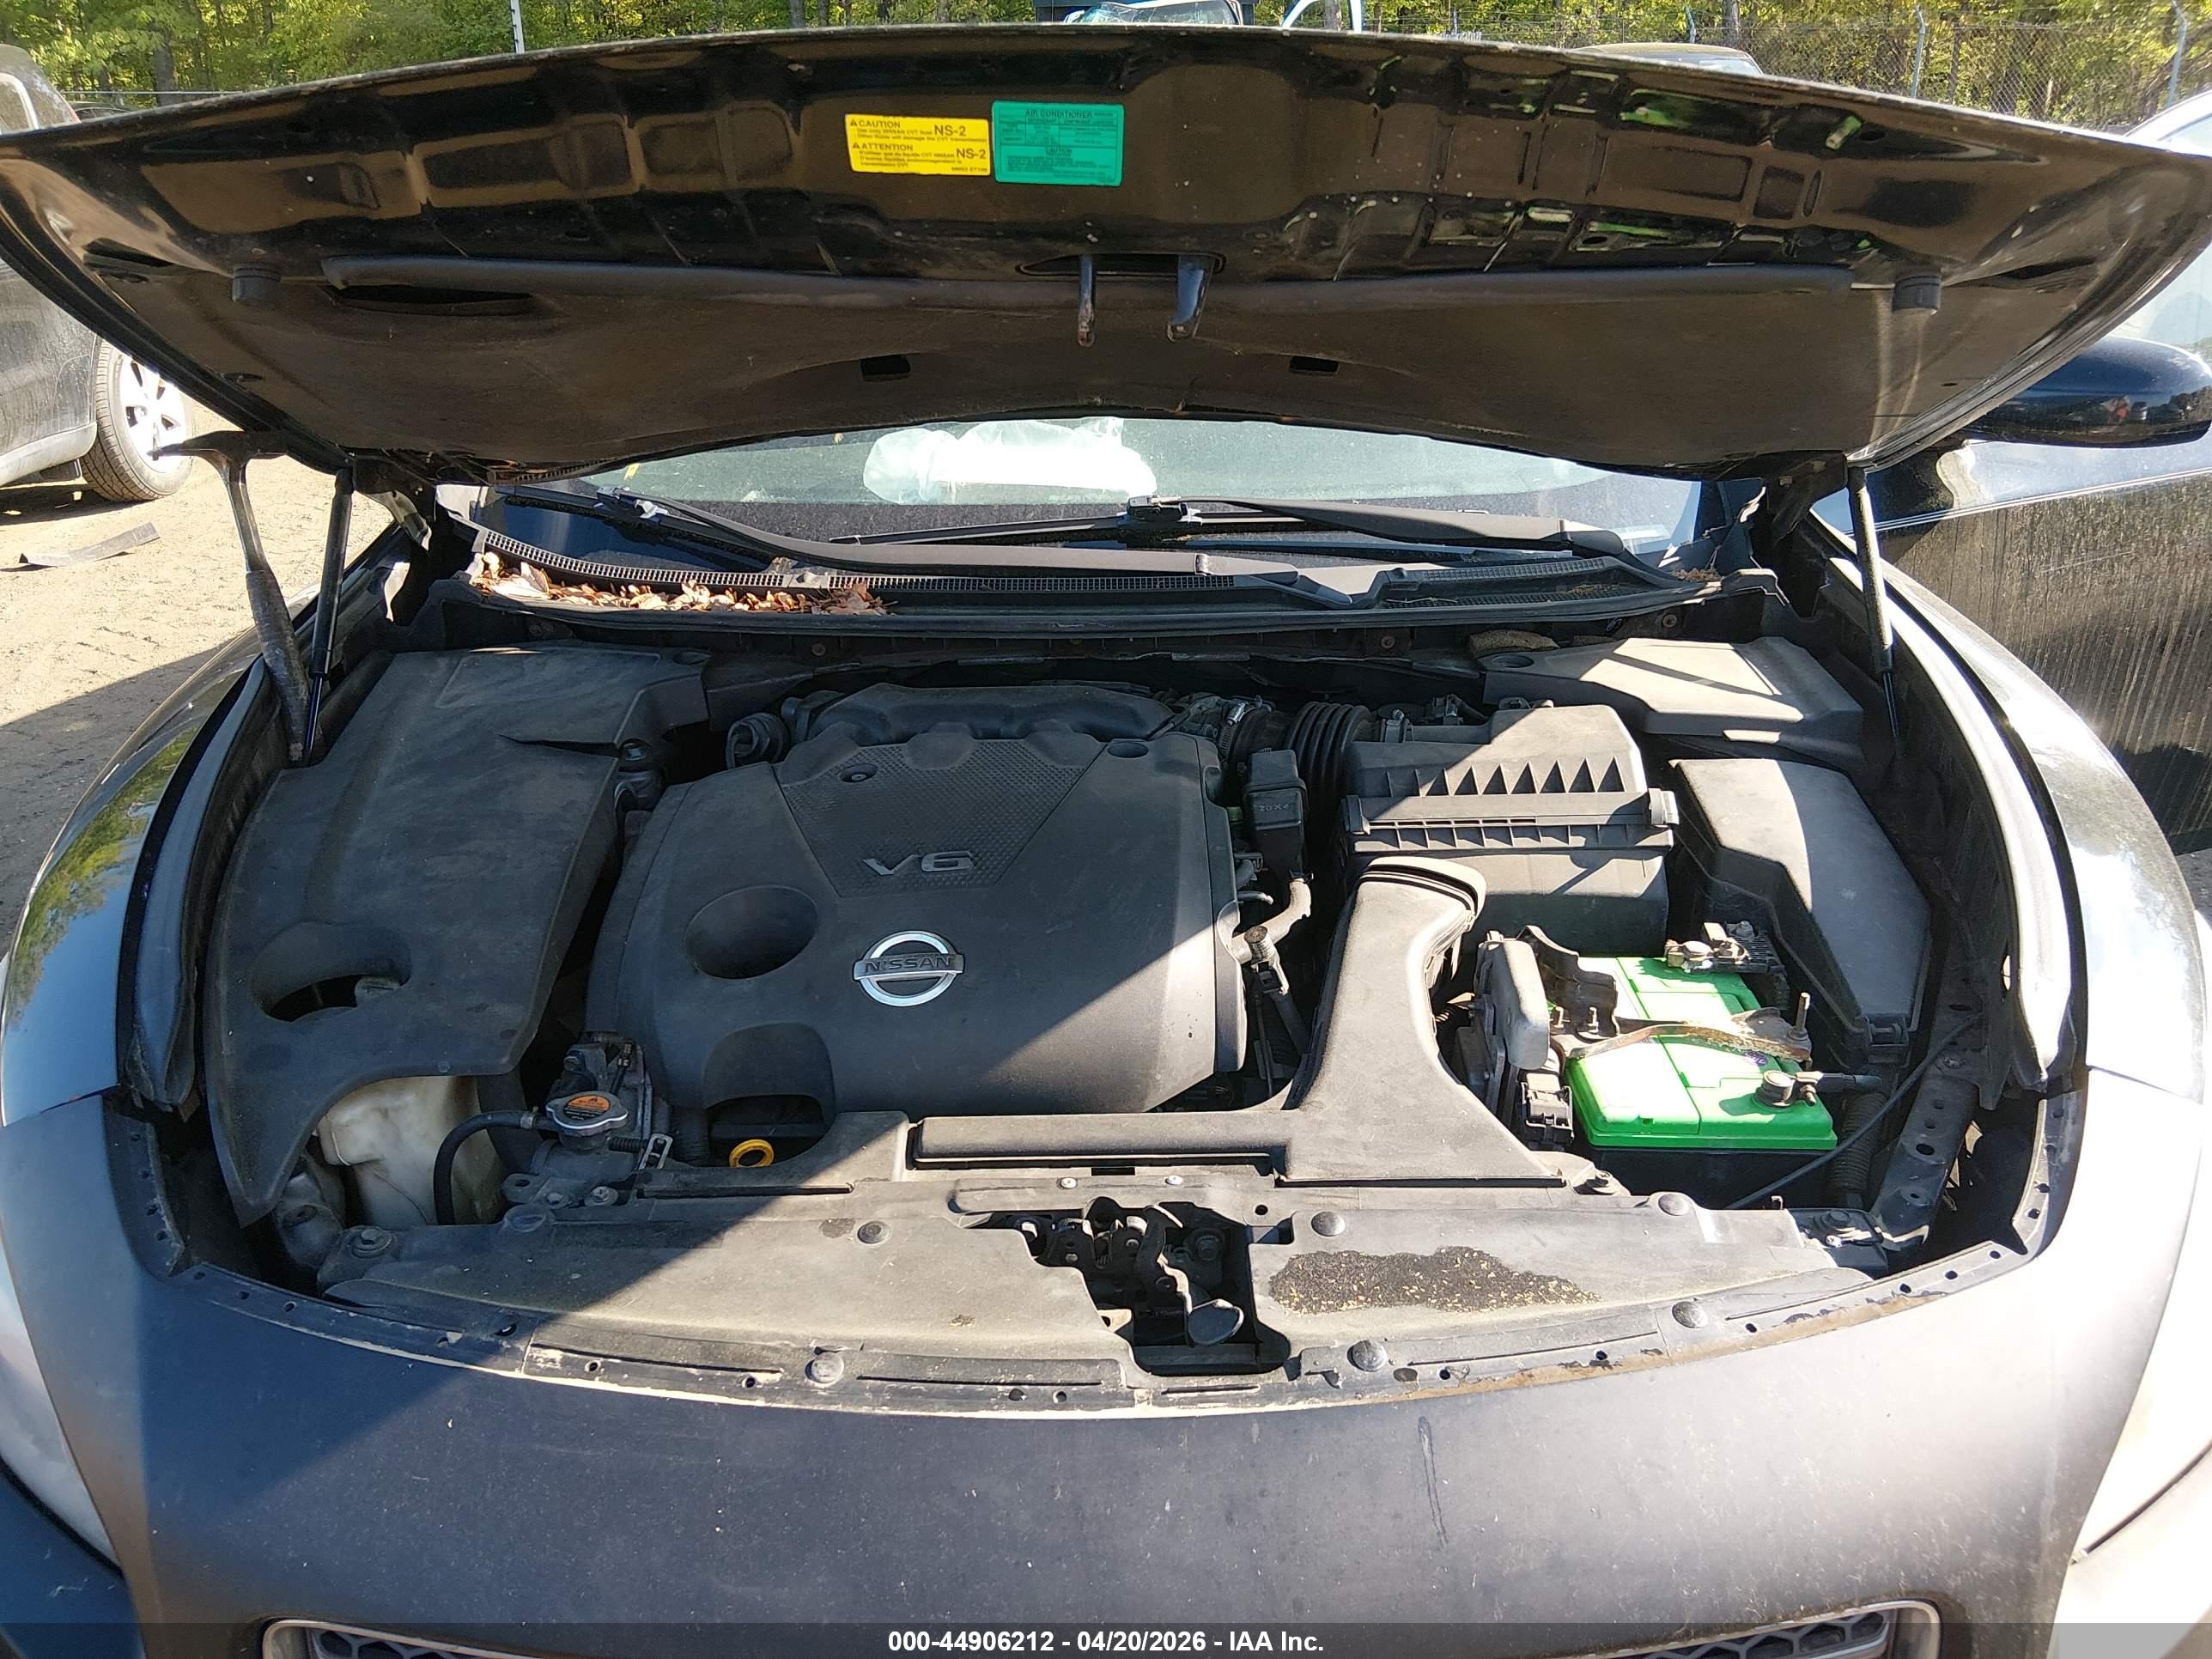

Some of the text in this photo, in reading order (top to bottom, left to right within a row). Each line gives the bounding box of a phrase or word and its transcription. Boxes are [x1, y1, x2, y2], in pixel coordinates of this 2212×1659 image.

[1041, 109, 1092, 118] CONDITIONER
[859, 119, 901, 129] CAUTION
[933, 124, 967, 137] NS-2
[861, 143, 914, 151] ATTENTION
[956, 148, 987, 160] NS-2
[862, 850, 974, 875] V6
[865, 955, 953, 974] NISSAN
